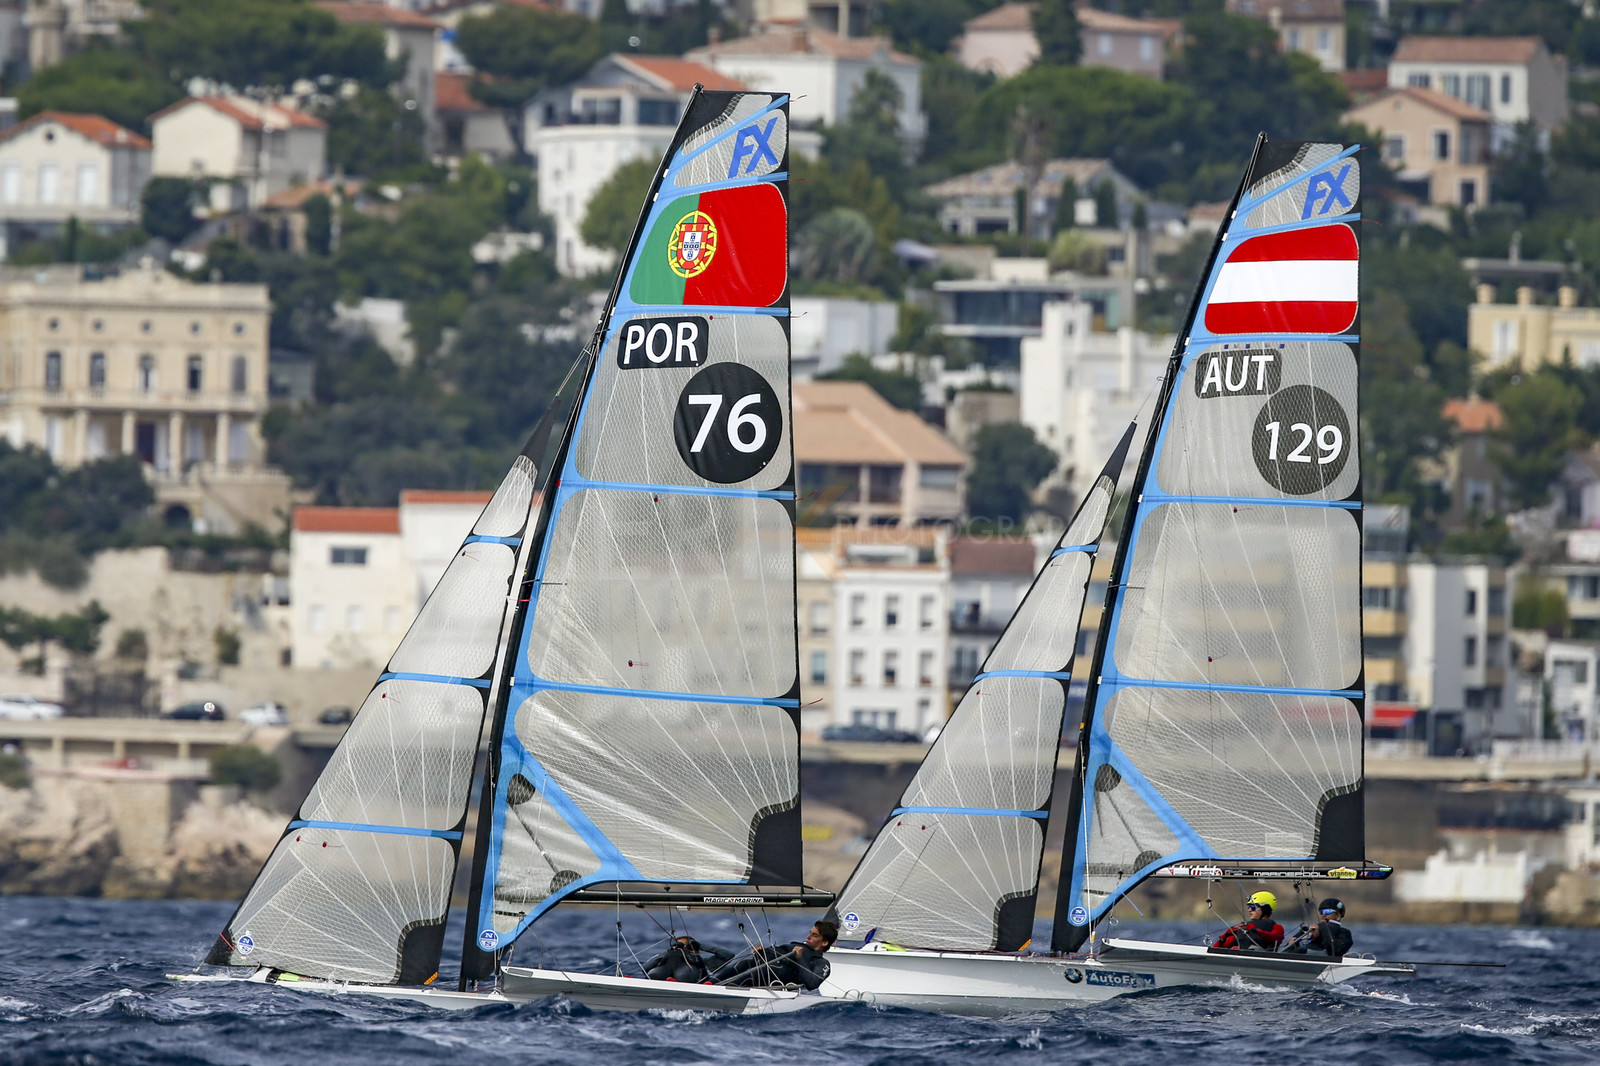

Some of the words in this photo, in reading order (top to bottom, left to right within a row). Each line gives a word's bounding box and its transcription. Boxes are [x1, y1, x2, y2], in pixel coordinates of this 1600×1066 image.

[727, 116, 779, 179] FX
[1301, 164, 1352, 221] FX
[622, 321, 700, 364] POR
[1200, 355, 1274, 394] AUT
[688, 392, 768, 453] 76
[1264, 421, 1344, 465] 129
